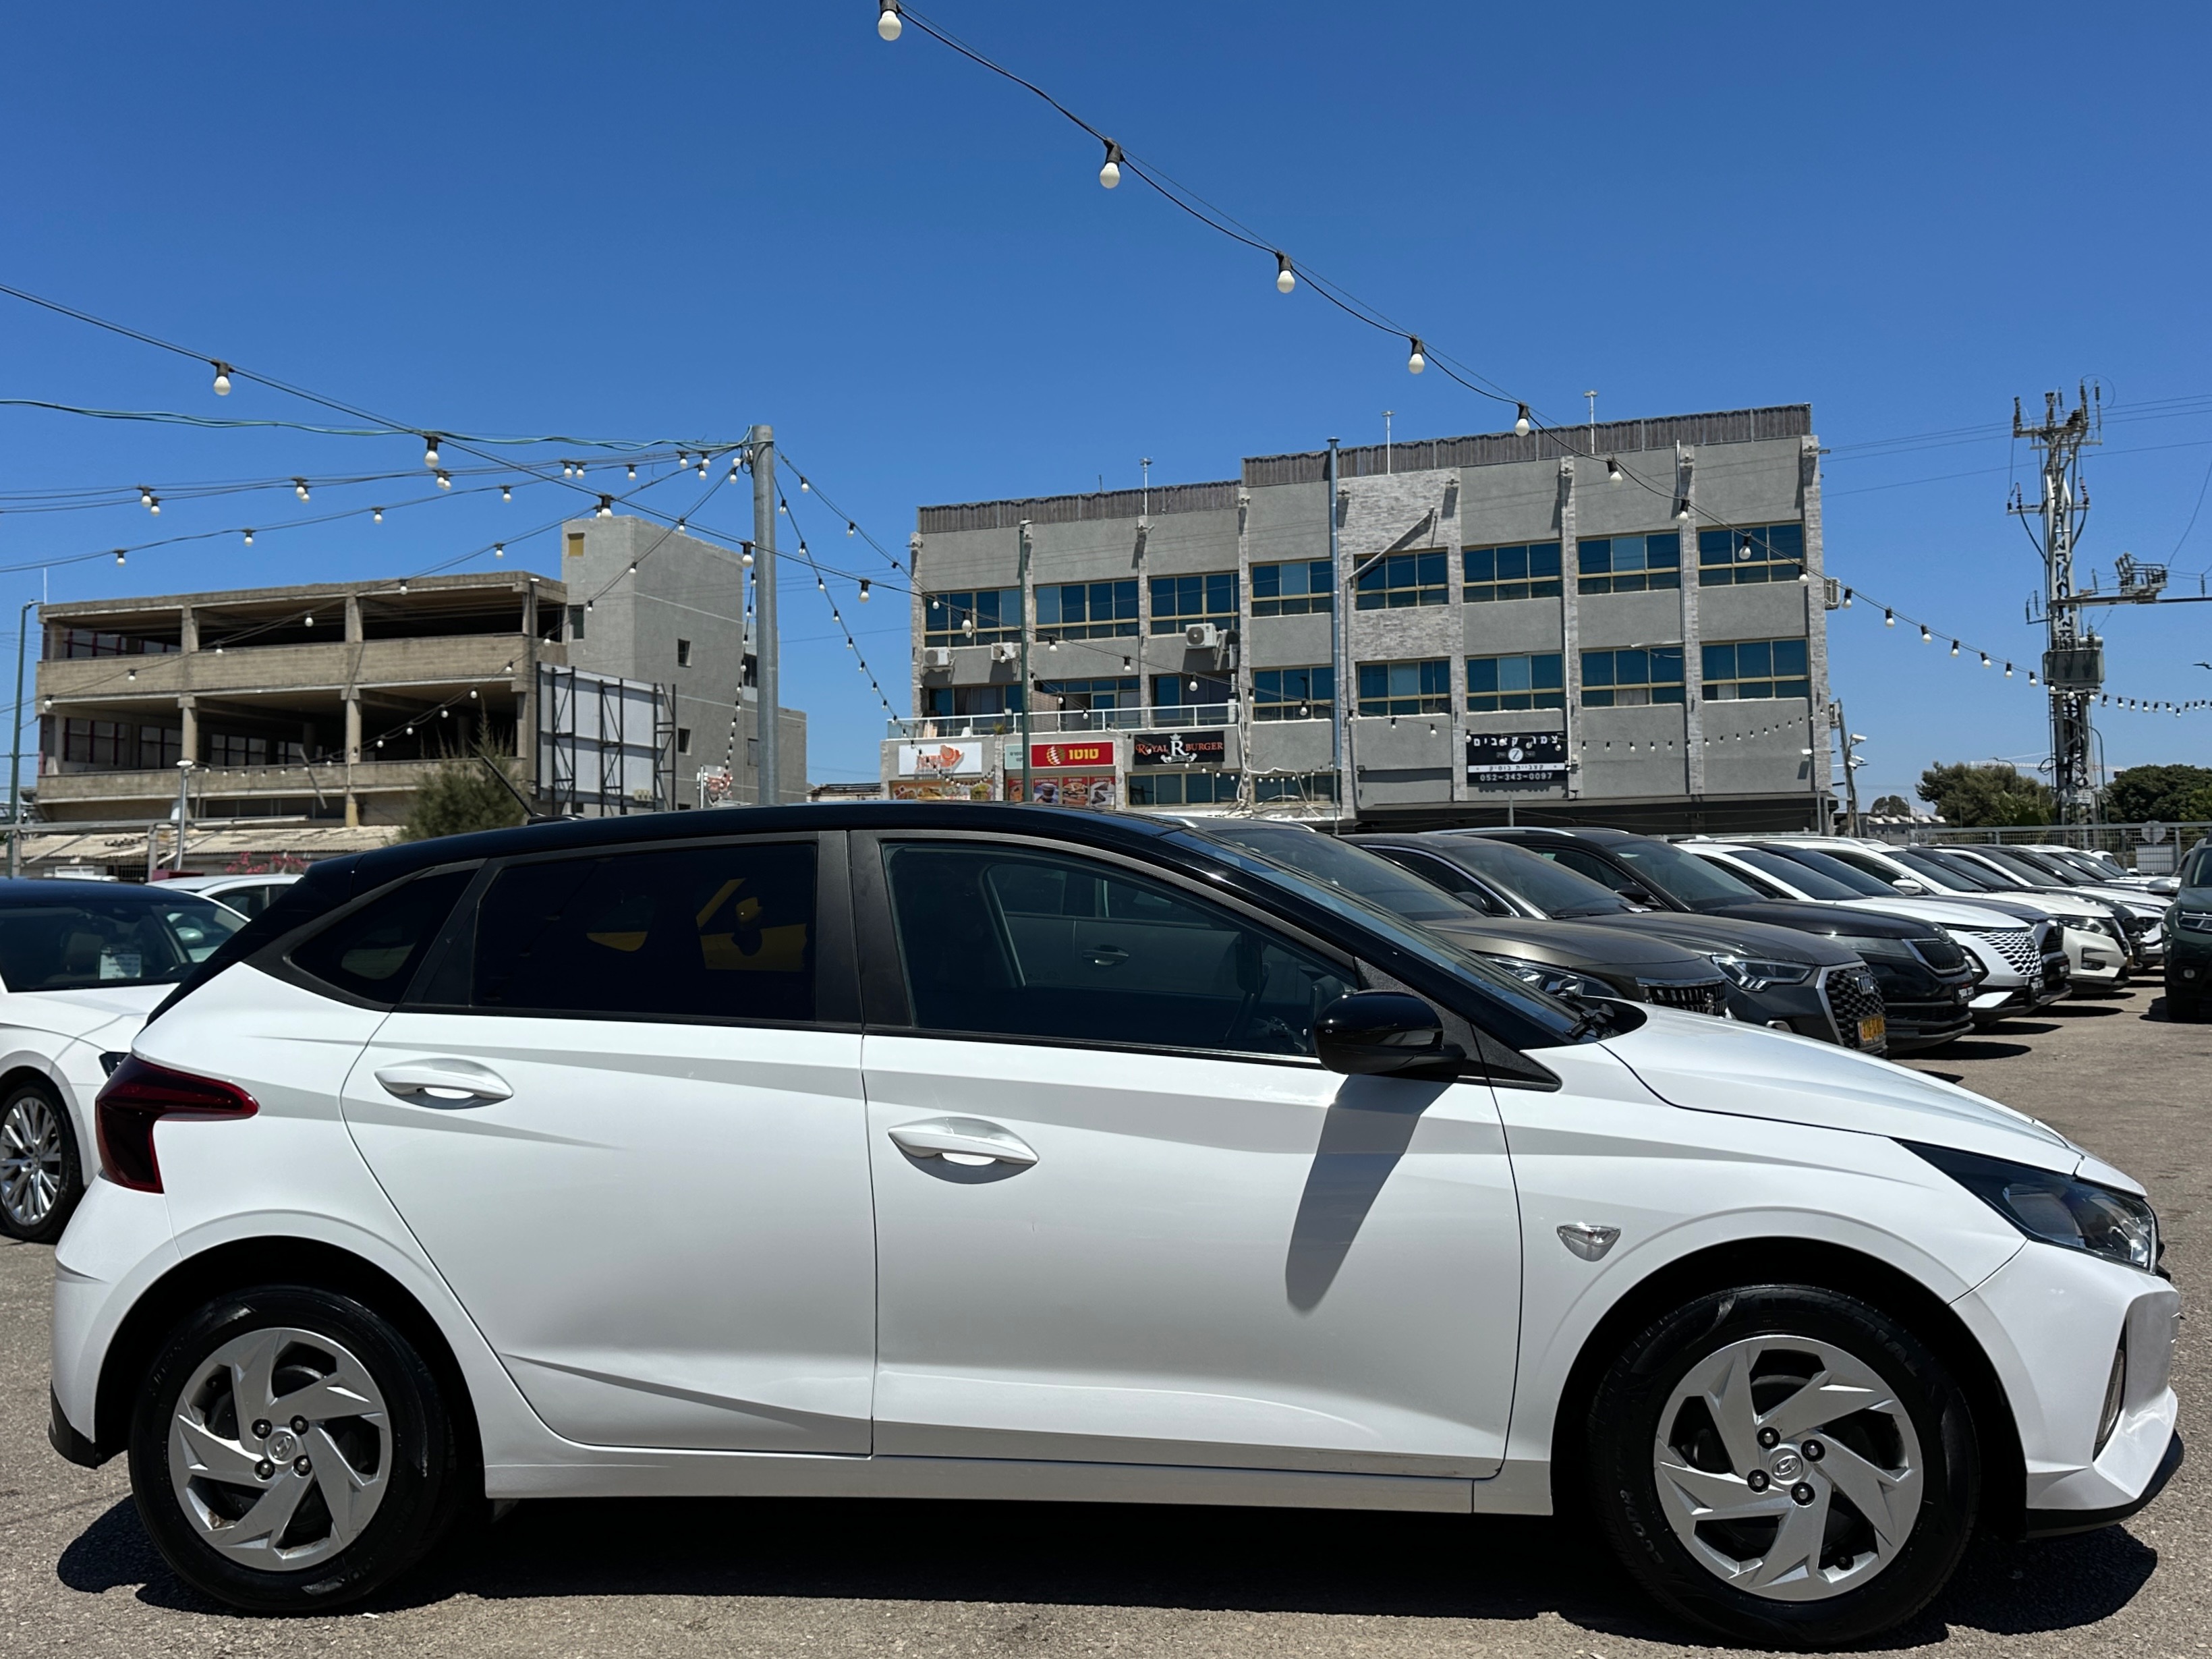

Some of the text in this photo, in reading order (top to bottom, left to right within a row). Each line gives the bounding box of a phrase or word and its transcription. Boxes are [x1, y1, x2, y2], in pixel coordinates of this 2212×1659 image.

[1170, 740, 1190, 756] R
[1185, 741, 1224, 752] BURGER
[1068, 748, 1100, 760] טוטו
[1480, 772, 1552, 781] 052-343-0097
